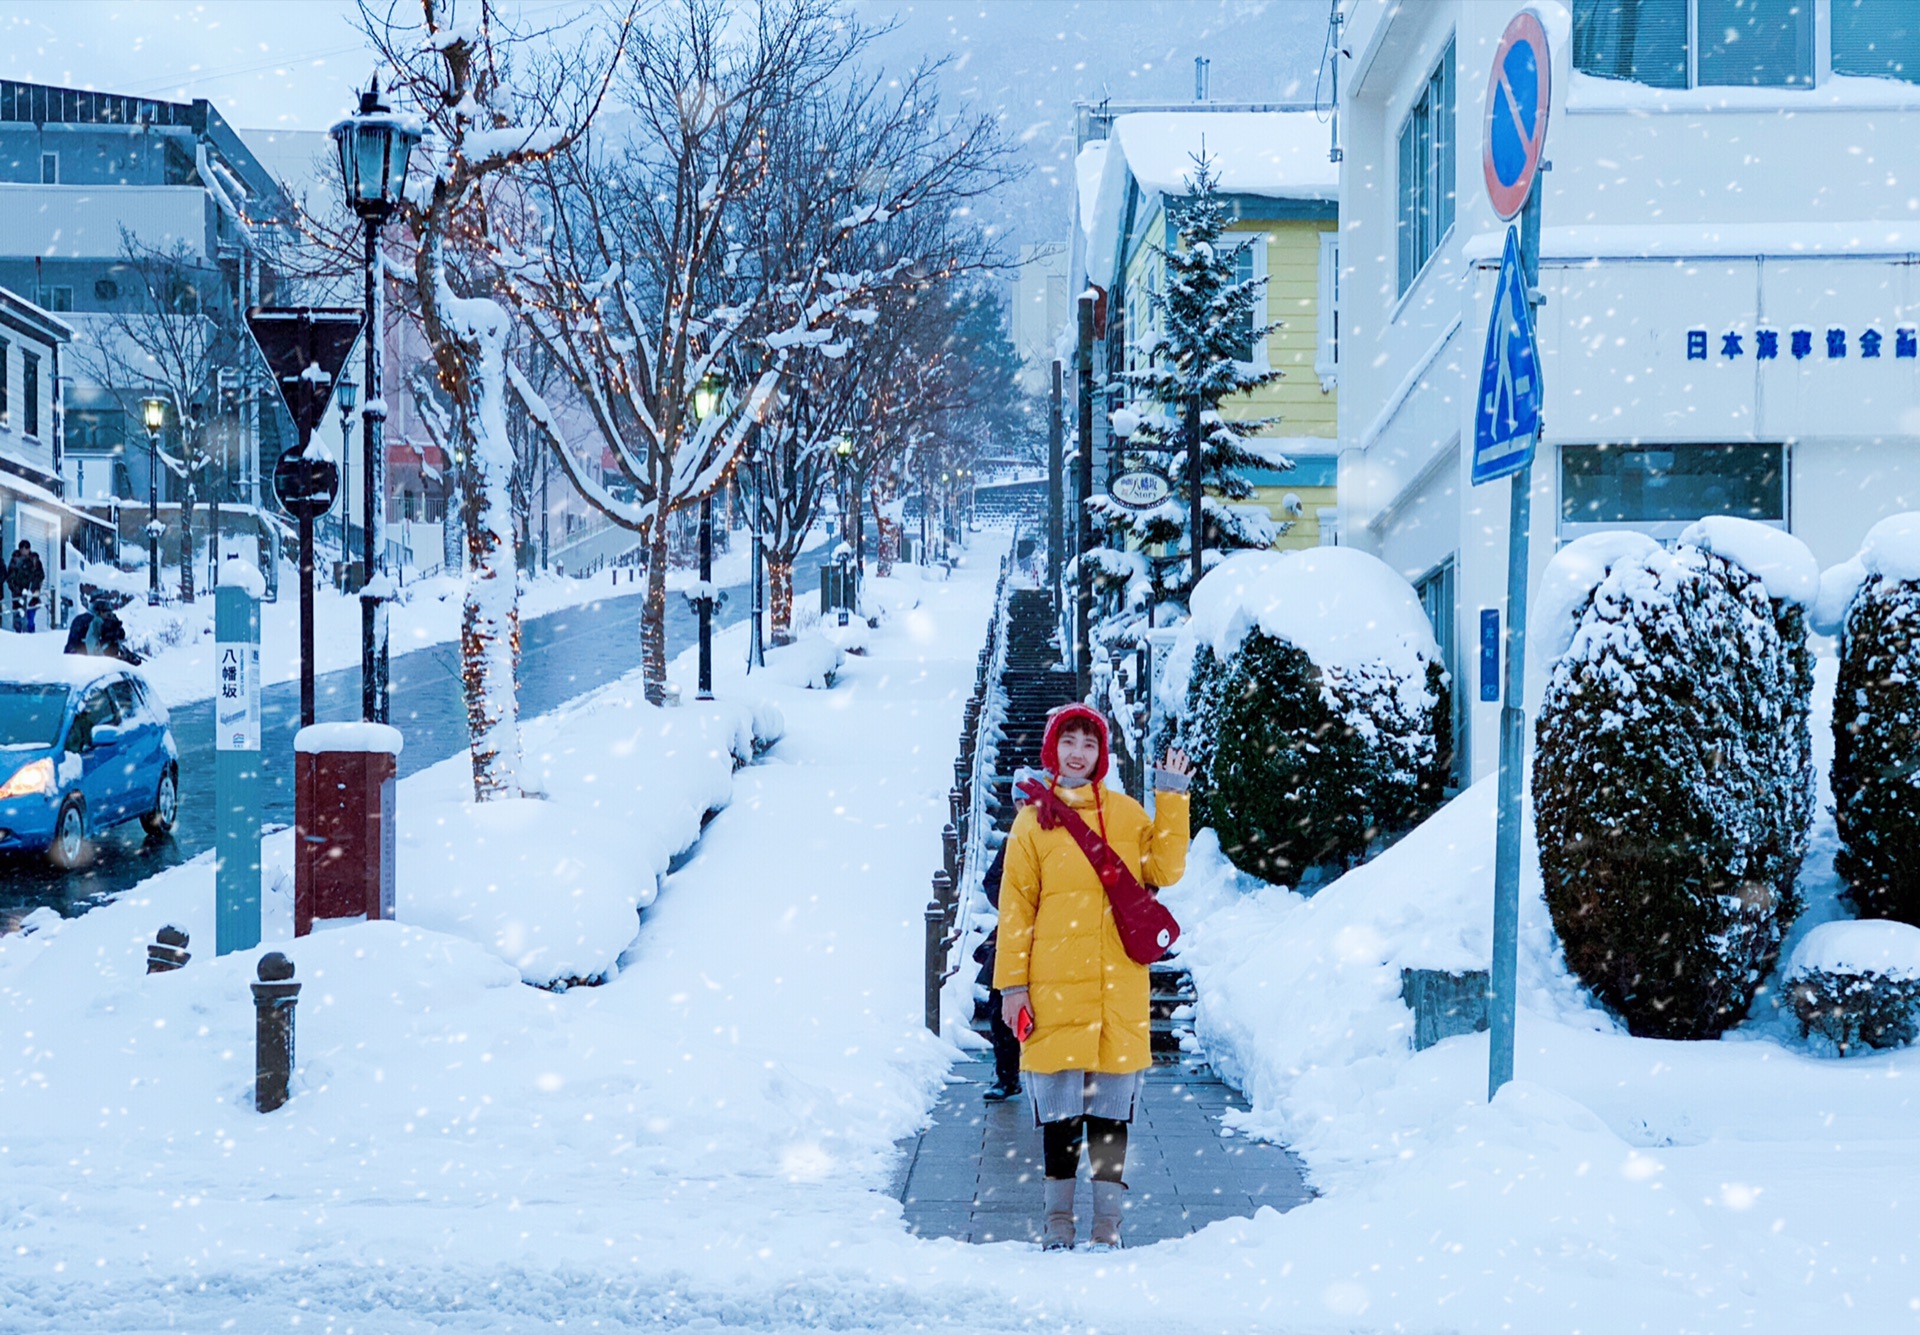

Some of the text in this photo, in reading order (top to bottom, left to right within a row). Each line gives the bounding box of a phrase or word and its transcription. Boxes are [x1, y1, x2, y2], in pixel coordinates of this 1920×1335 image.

[1134, 490, 1157, 499] Story
[222, 649, 237, 698] 八幡坂
